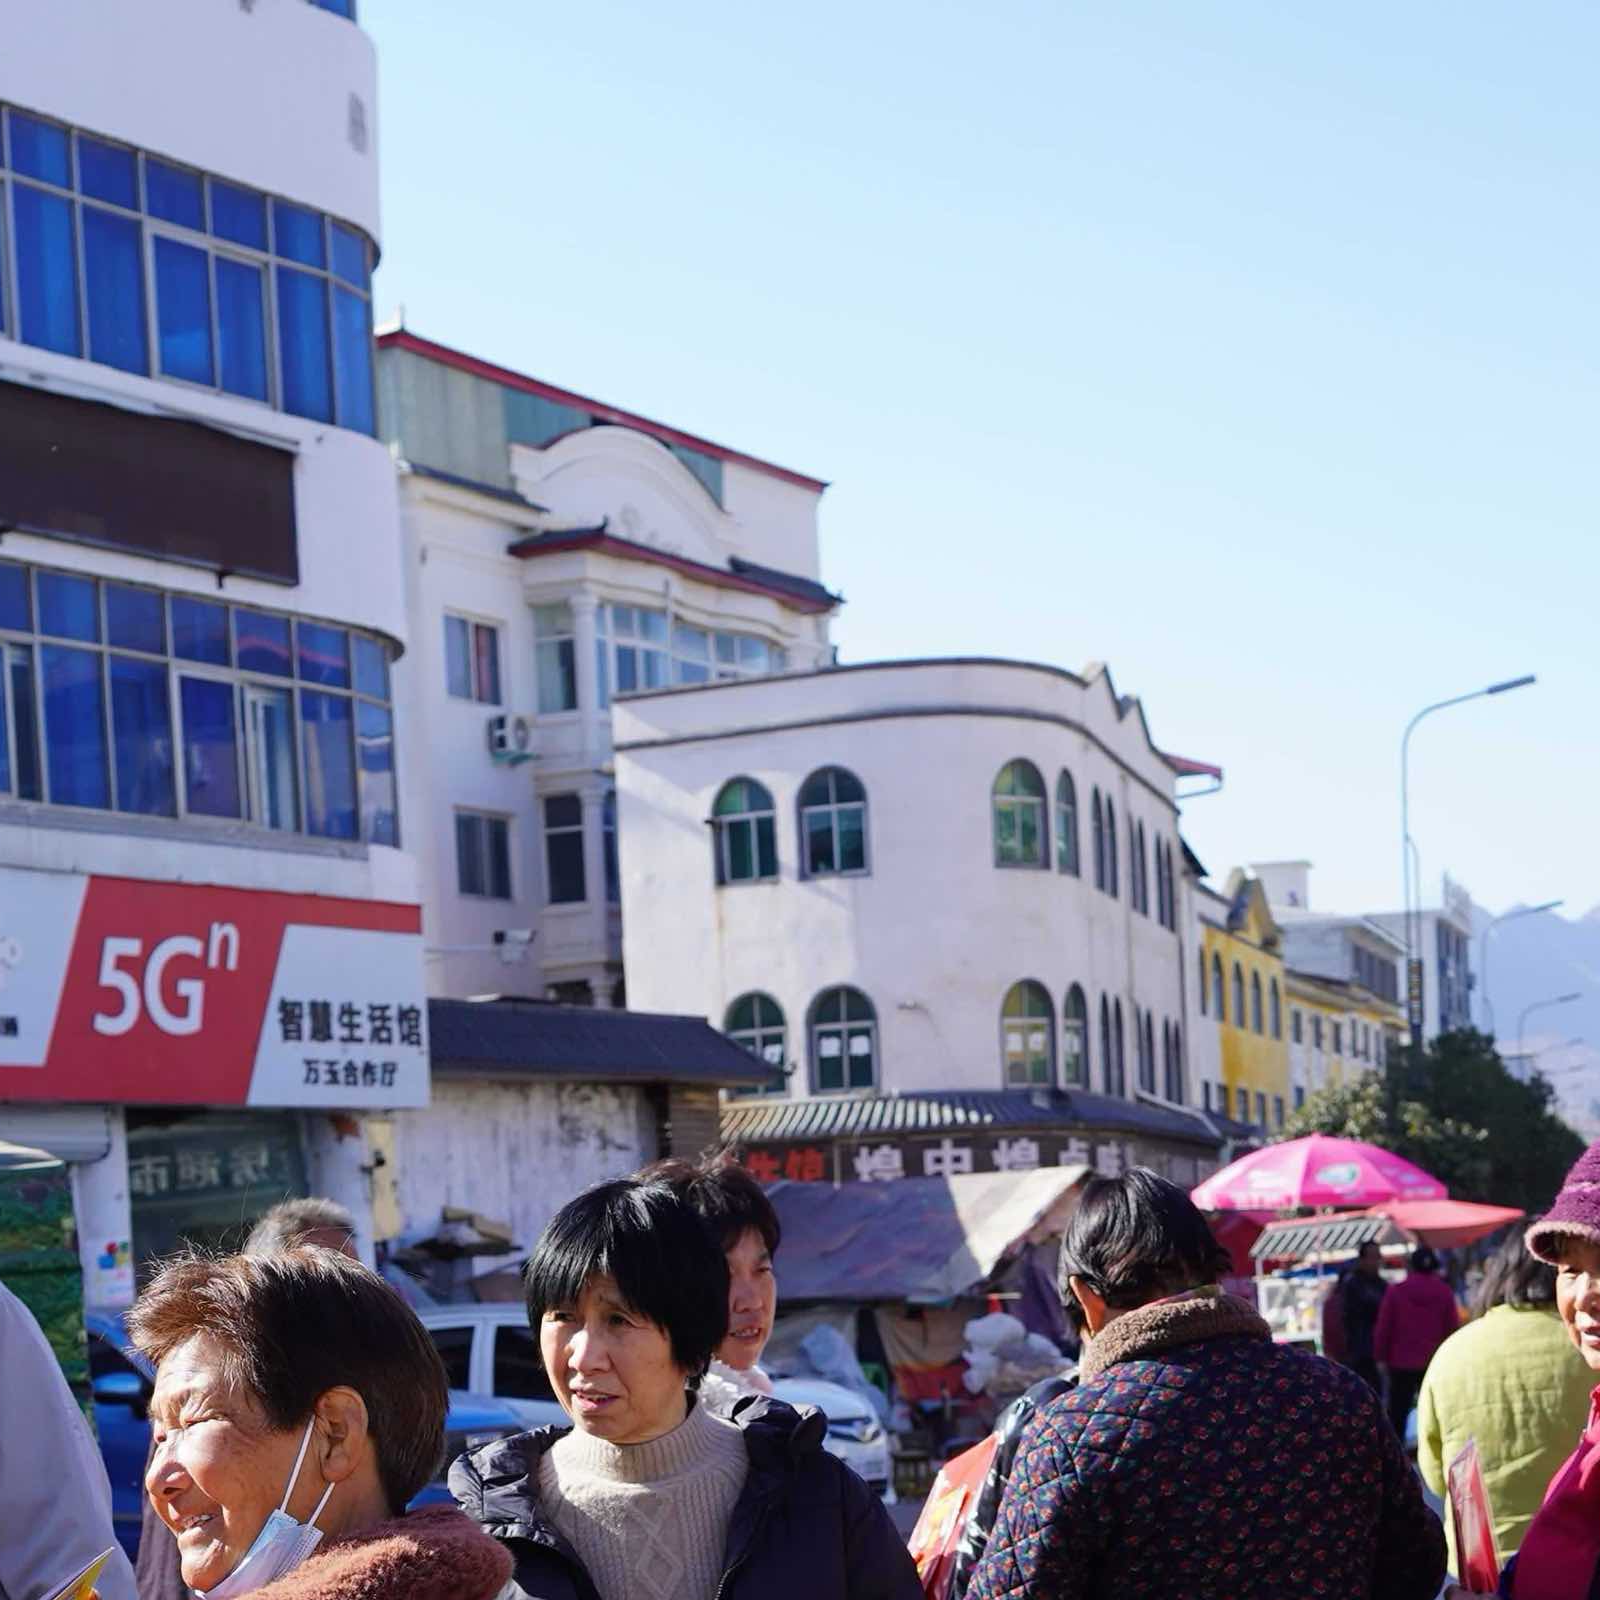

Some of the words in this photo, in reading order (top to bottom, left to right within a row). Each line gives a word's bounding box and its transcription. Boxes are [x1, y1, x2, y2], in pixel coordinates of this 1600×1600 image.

[278, 996, 423, 1047] 智慧生活馆
